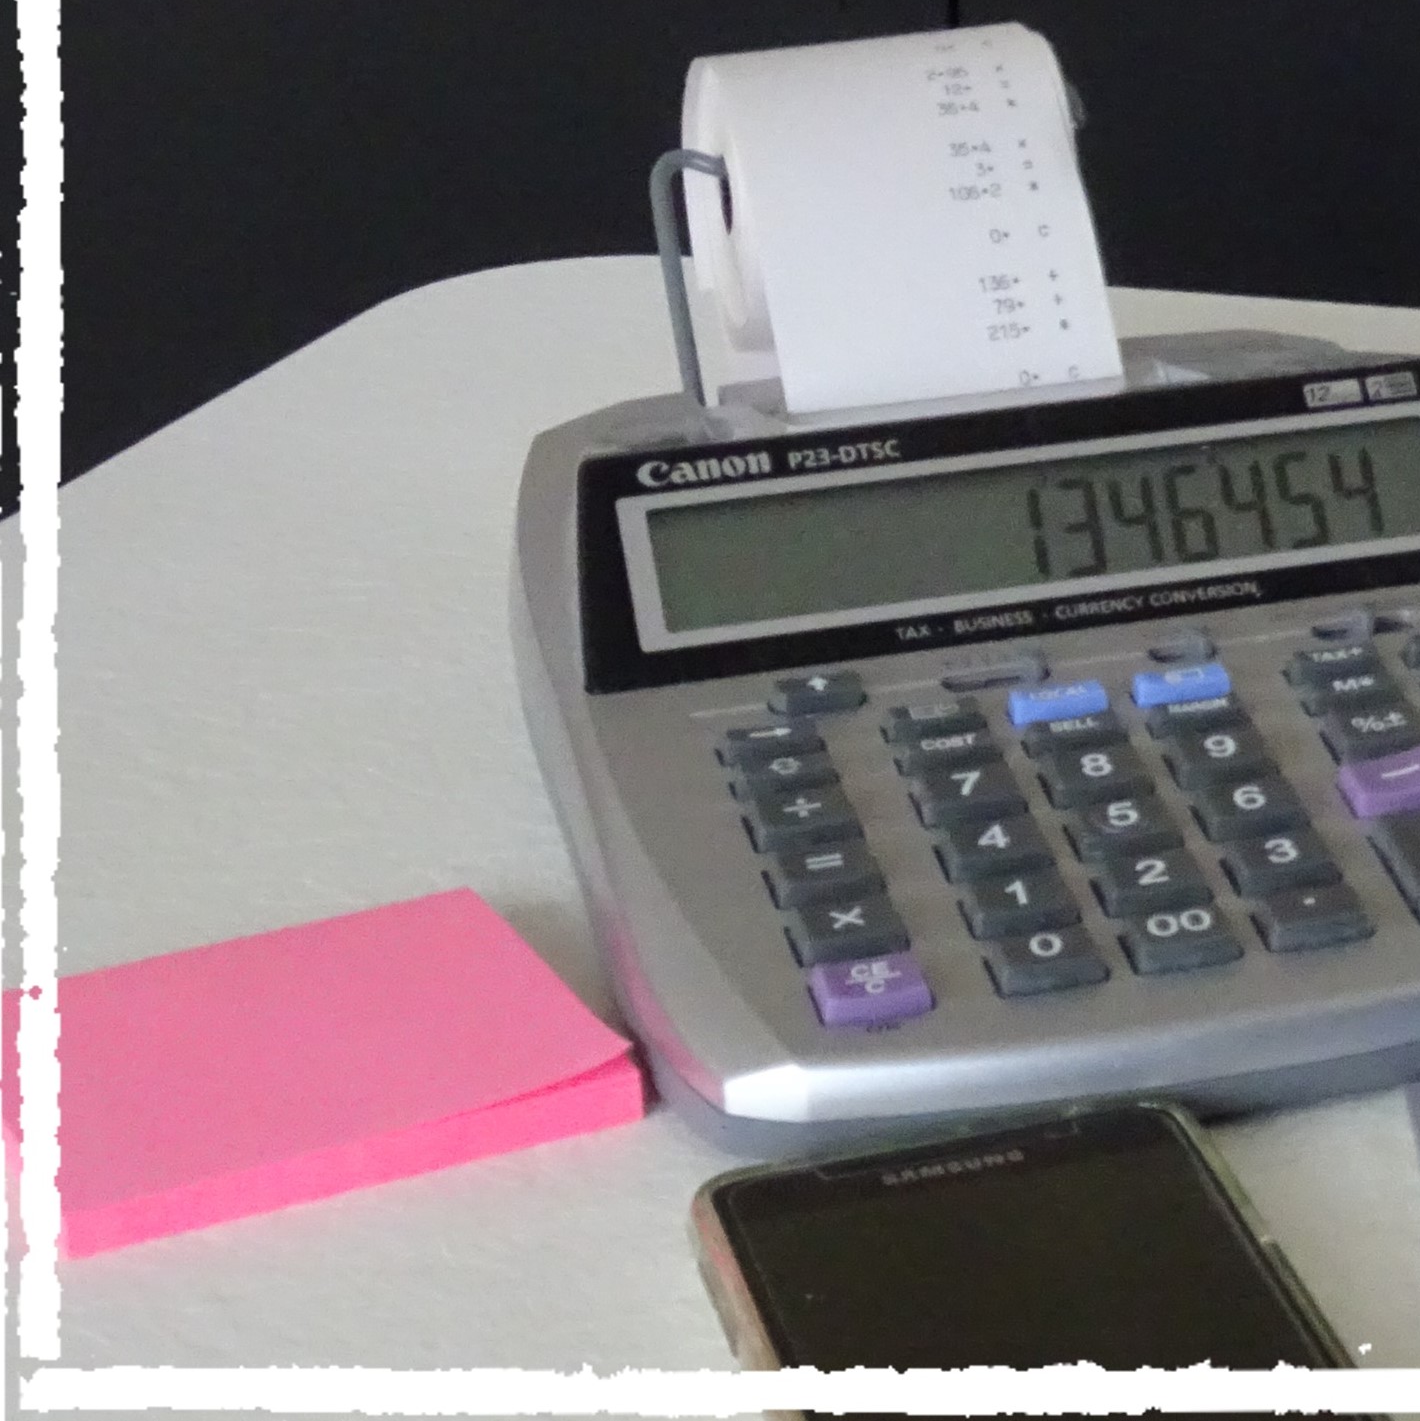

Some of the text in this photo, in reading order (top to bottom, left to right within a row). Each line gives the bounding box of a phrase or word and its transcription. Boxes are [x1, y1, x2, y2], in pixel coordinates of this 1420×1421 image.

[636, 439, 900, 487] Canon P23-DTSC
[1026, 447, 1385, 578] 1346454
[896, 624, 931, 640] TAX
[953, 610, 1033, 633] BUSINESS
[1054, 593, 1145, 620] CURRENCY
[920, 733, 977, 750] COST
[1203, 734, 1236, 758] 9
[1080, 752, 1113, 777] 8
[951, 770, 981, 796] 7
[1233, 785, 1266, 809] 6
[1107, 801, 1139, 826] 5
[977, 823, 1010, 849] 4
[1265, 838, 1298, 863] 3
[1135, 859, 1170, 886] 2
[1004, 880, 1028, 905] 1
[1147, 909, 1211, 936] 00
[1029, 933, 1063, 956] 0
